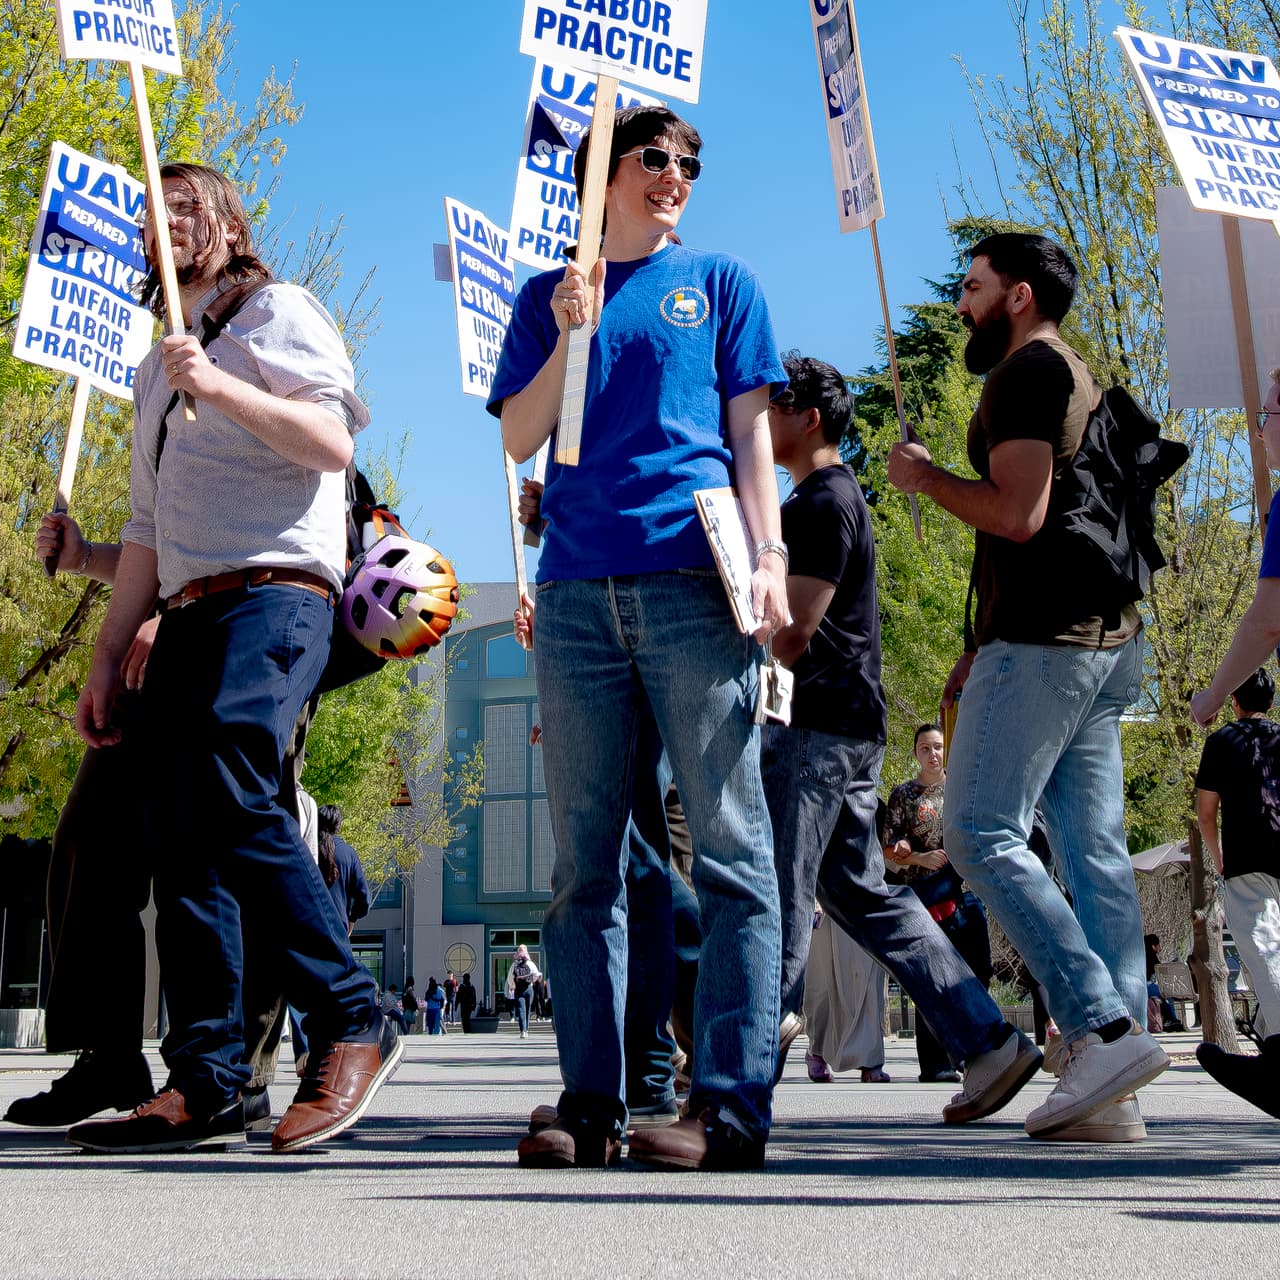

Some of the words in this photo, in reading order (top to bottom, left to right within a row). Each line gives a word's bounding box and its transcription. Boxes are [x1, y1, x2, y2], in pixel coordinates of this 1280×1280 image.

[73, 9, 176, 57] PRACTICE
[534, 6, 693, 83] PRACTICE
[1130, 35, 1266, 84] UAW
[1153, 75, 1248, 104] PREPARED
[1252, 93, 1279, 109] TO
[63, 199, 128, 246] PREPARED
[452, 206, 508, 263] UAW
[460, 250, 501, 285] PREPARED
[502, 276, 513, 293] TO
[50, 276, 132, 332] UNFAIR
[50, 305, 124, 356] LABOR
[25, 326, 137, 389] PRACTICE
